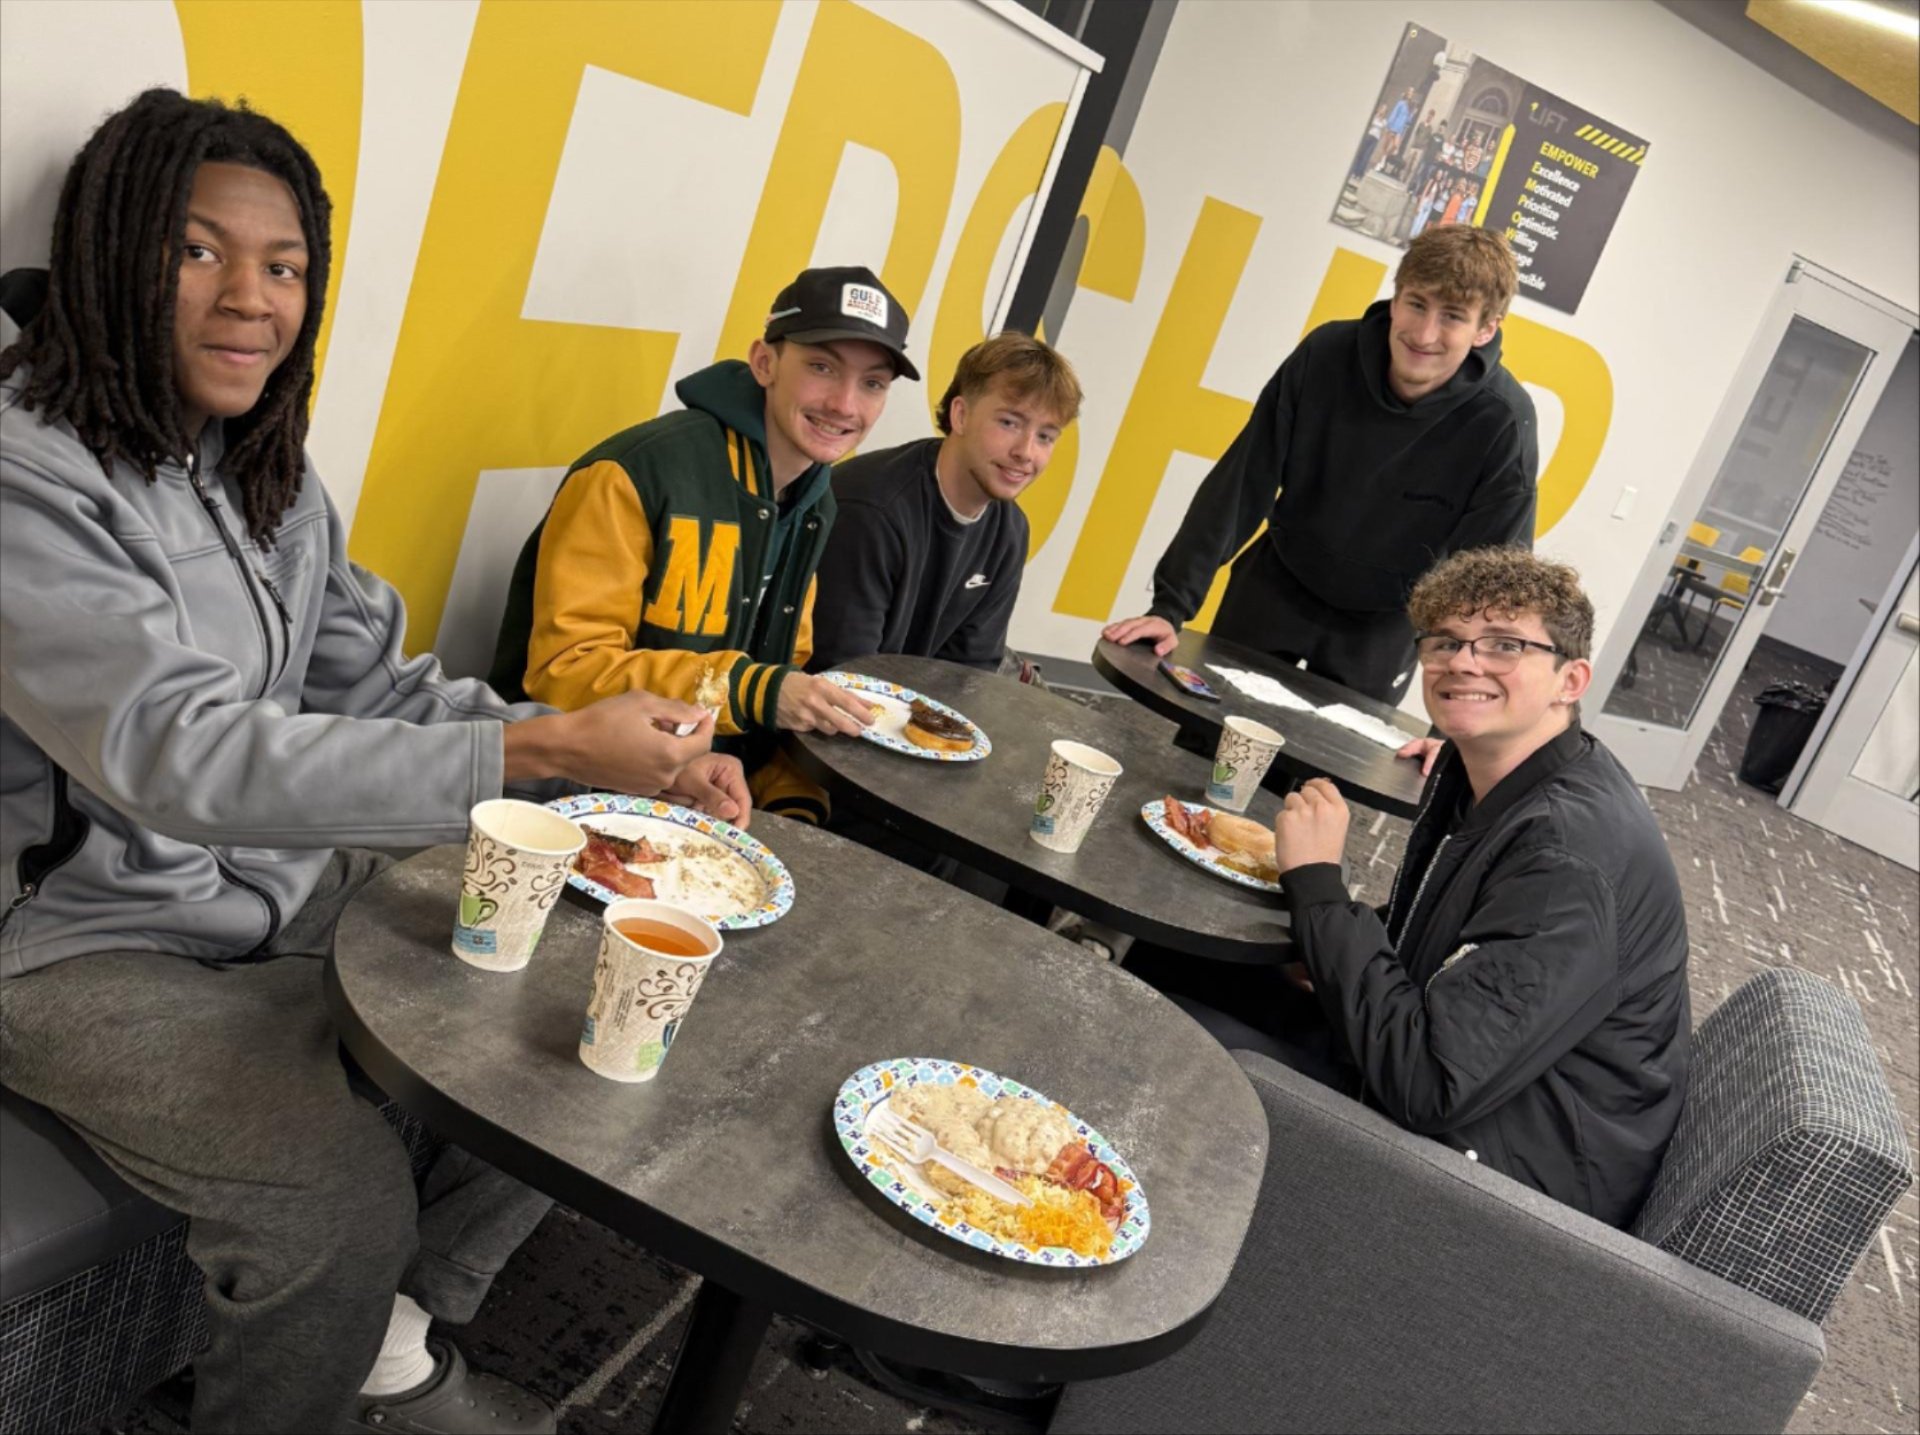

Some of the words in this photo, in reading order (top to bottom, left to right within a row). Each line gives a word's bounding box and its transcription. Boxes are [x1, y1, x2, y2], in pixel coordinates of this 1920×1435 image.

[1529, 107, 1568, 134] LIFT
[1540, 141, 1599, 179] EMPOWER
[1531, 161, 1580, 192] Excellence
[1524, 177, 1573, 208] Motivated
[1518, 194, 1560, 221] Prioritize
[1505, 227, 1538, 252] Willing
[1511, 212, 1559, 240] Optimistic
[643, 516, 741, 637] M
